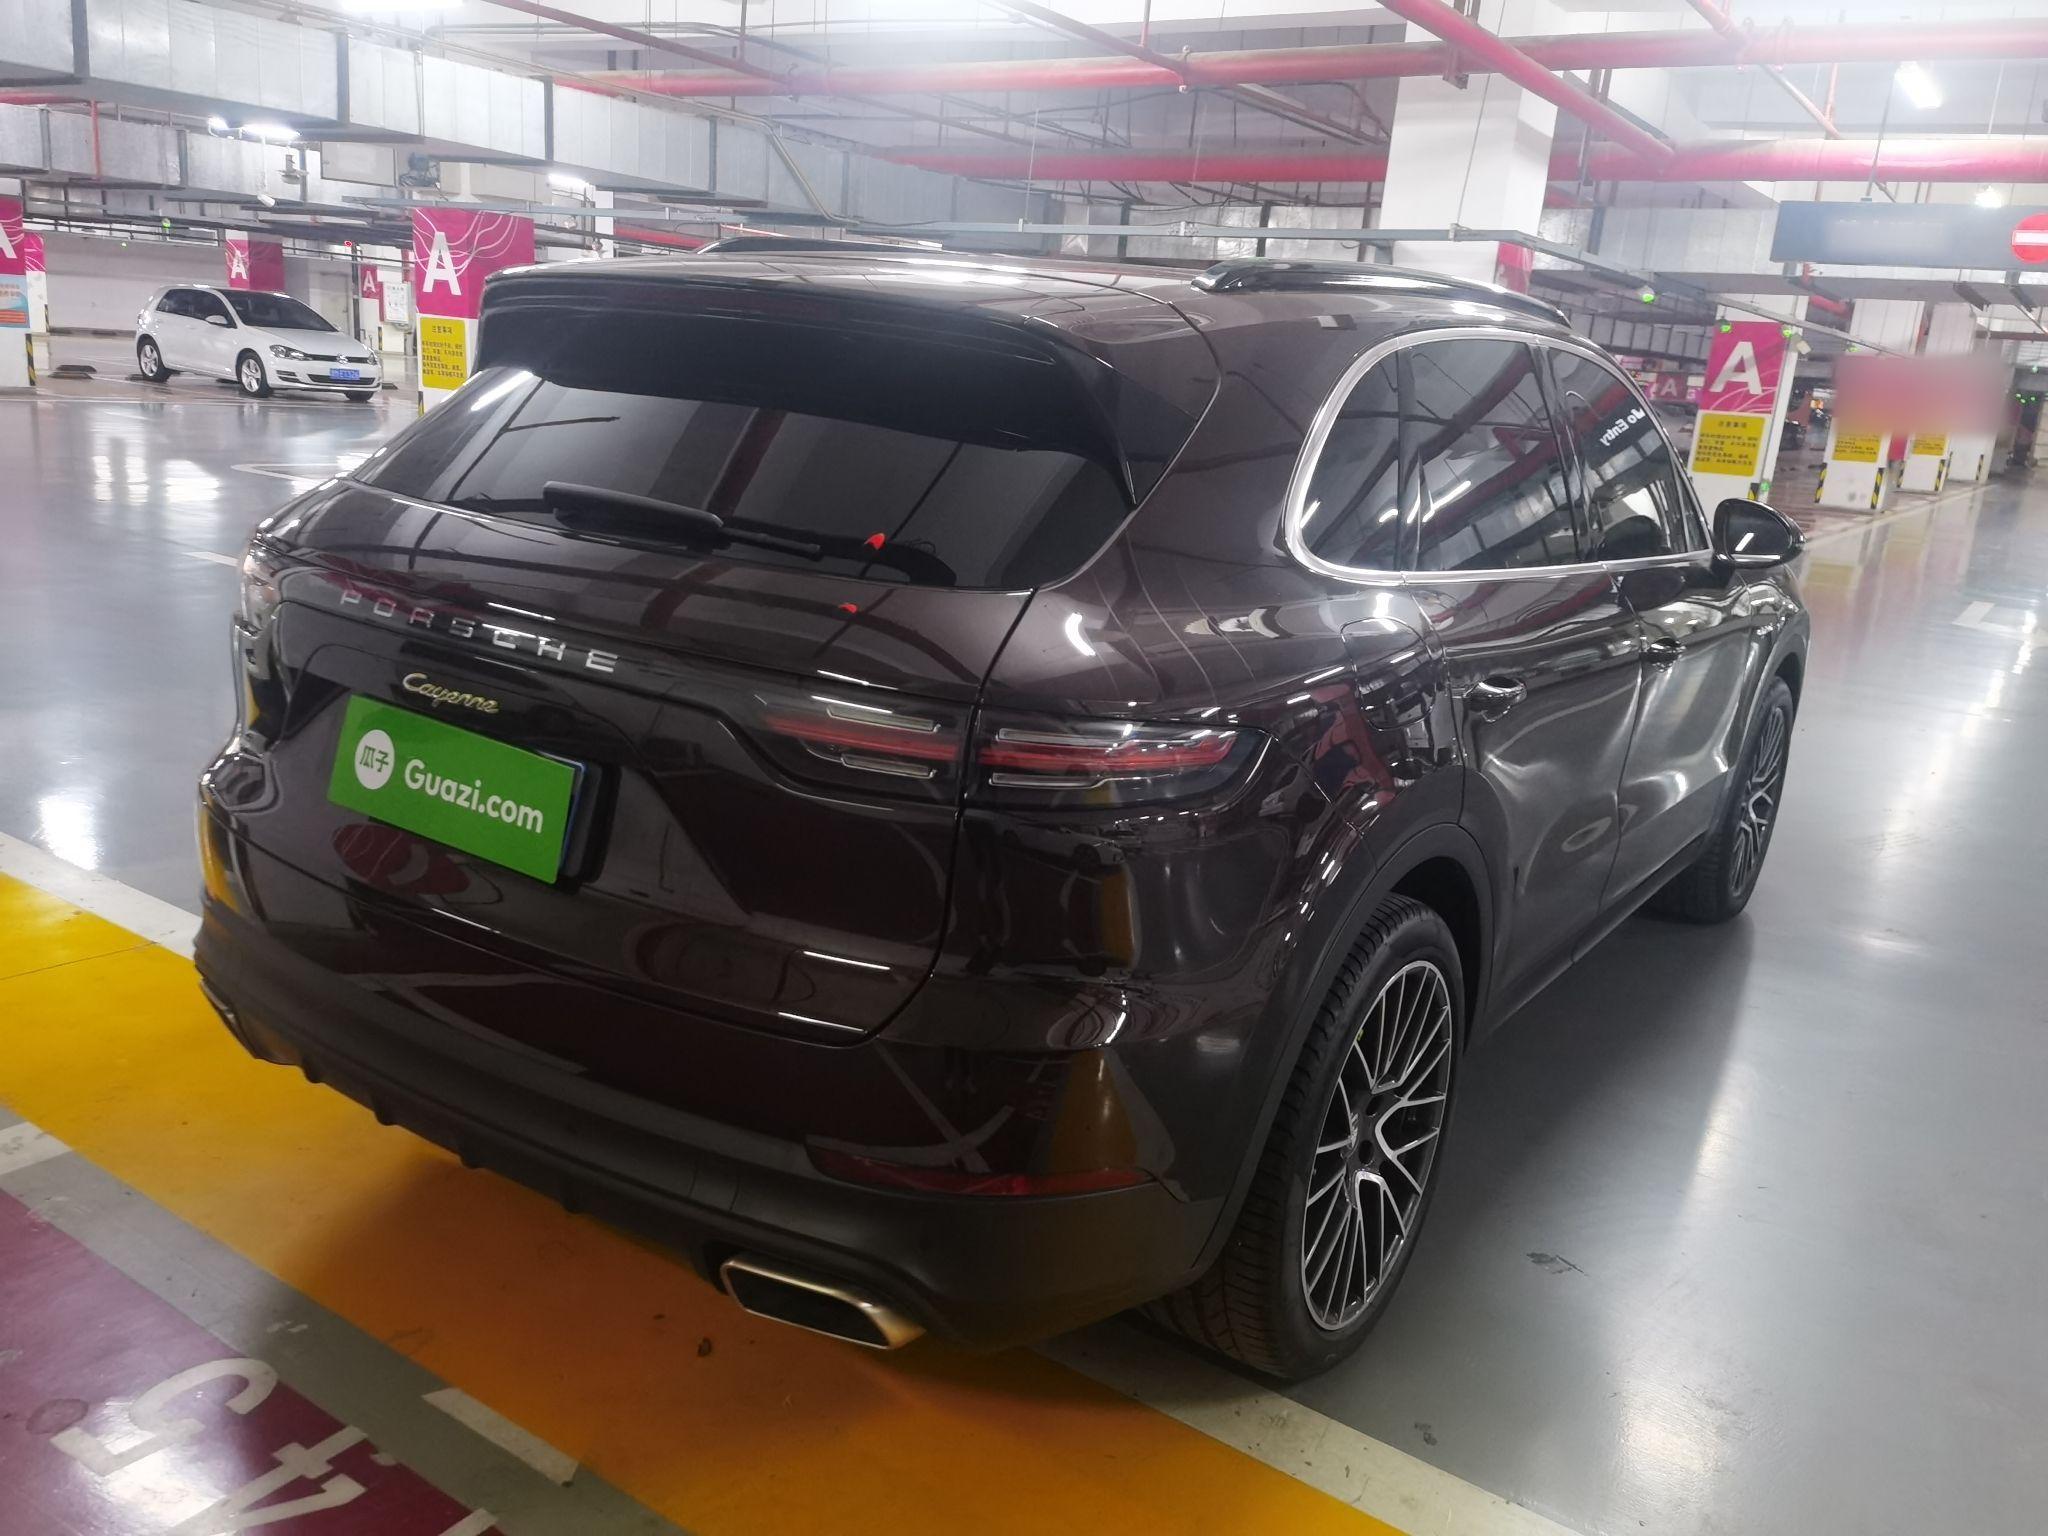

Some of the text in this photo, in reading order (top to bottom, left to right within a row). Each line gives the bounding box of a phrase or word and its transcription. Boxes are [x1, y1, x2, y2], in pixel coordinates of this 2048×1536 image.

[231, 249, 248, 280] A
[363, 271, 376, 293] A
[422, 232, 462, 296] A
[1660, 378, 1678, 397] A
[1709, 341, 1763, 395] A
[340, 588, 620, 673] PORSCHE
[402, 672, 500, 714] Cayenne
[359, 745, 389, 772] 瓜子
[404, 758, 544, 834] Guazi.com
